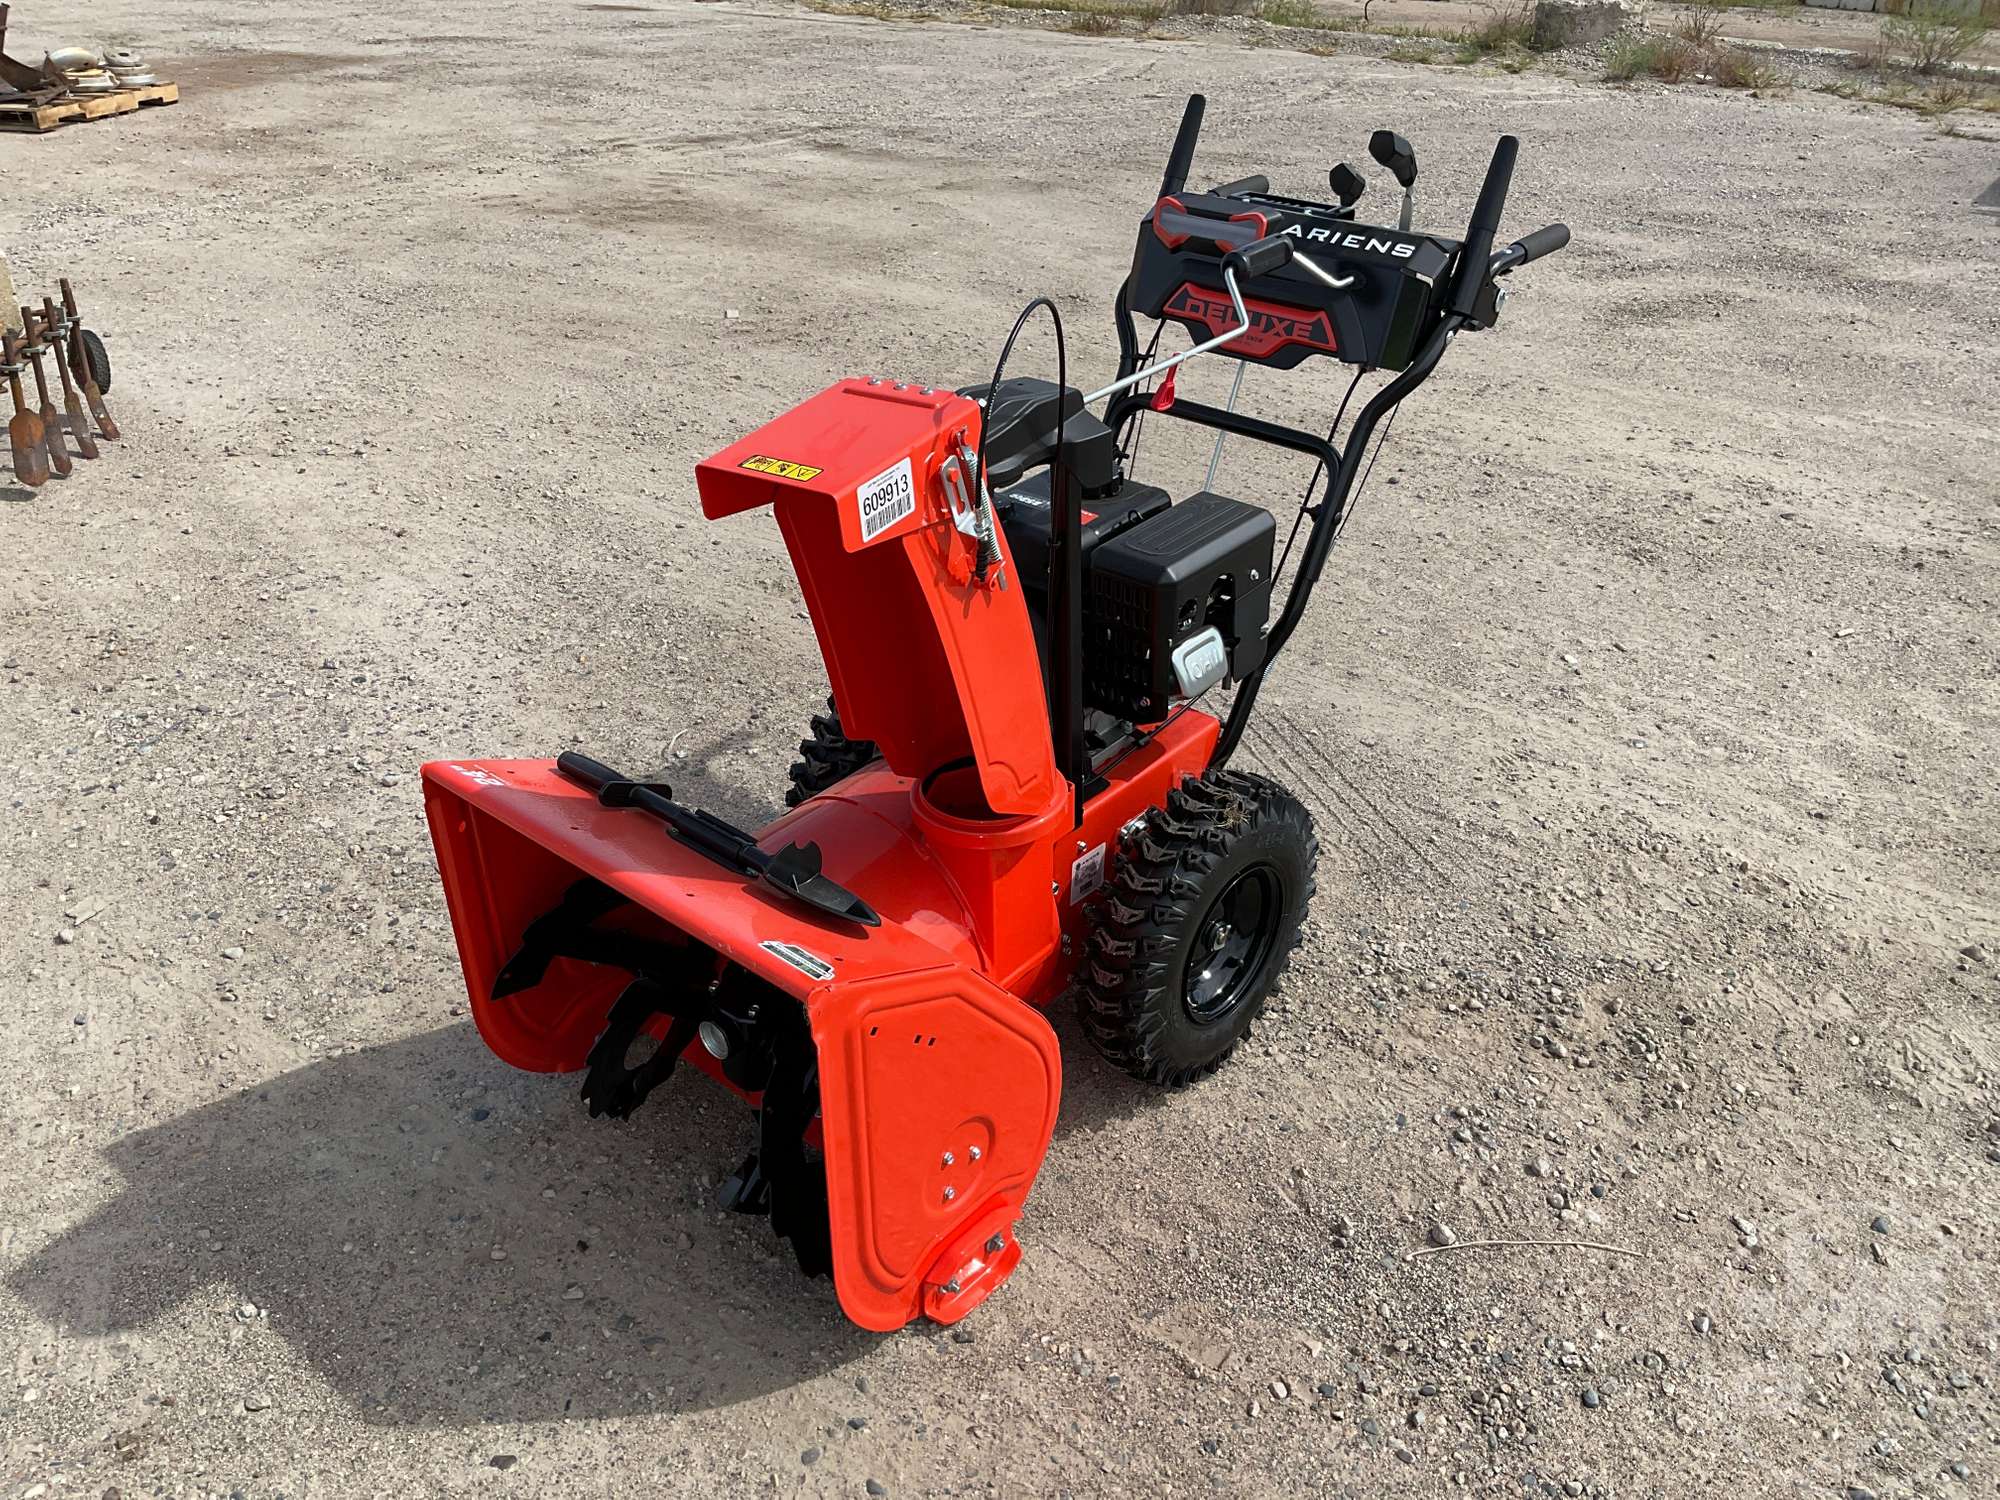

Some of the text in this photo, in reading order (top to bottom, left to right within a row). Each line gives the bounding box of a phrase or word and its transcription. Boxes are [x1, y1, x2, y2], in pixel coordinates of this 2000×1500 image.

[1280, 224, 1416, 258] ARIENS
[1184, 298, 1313, 338] DELUXE
[863, 474, 909, 516] 609913
